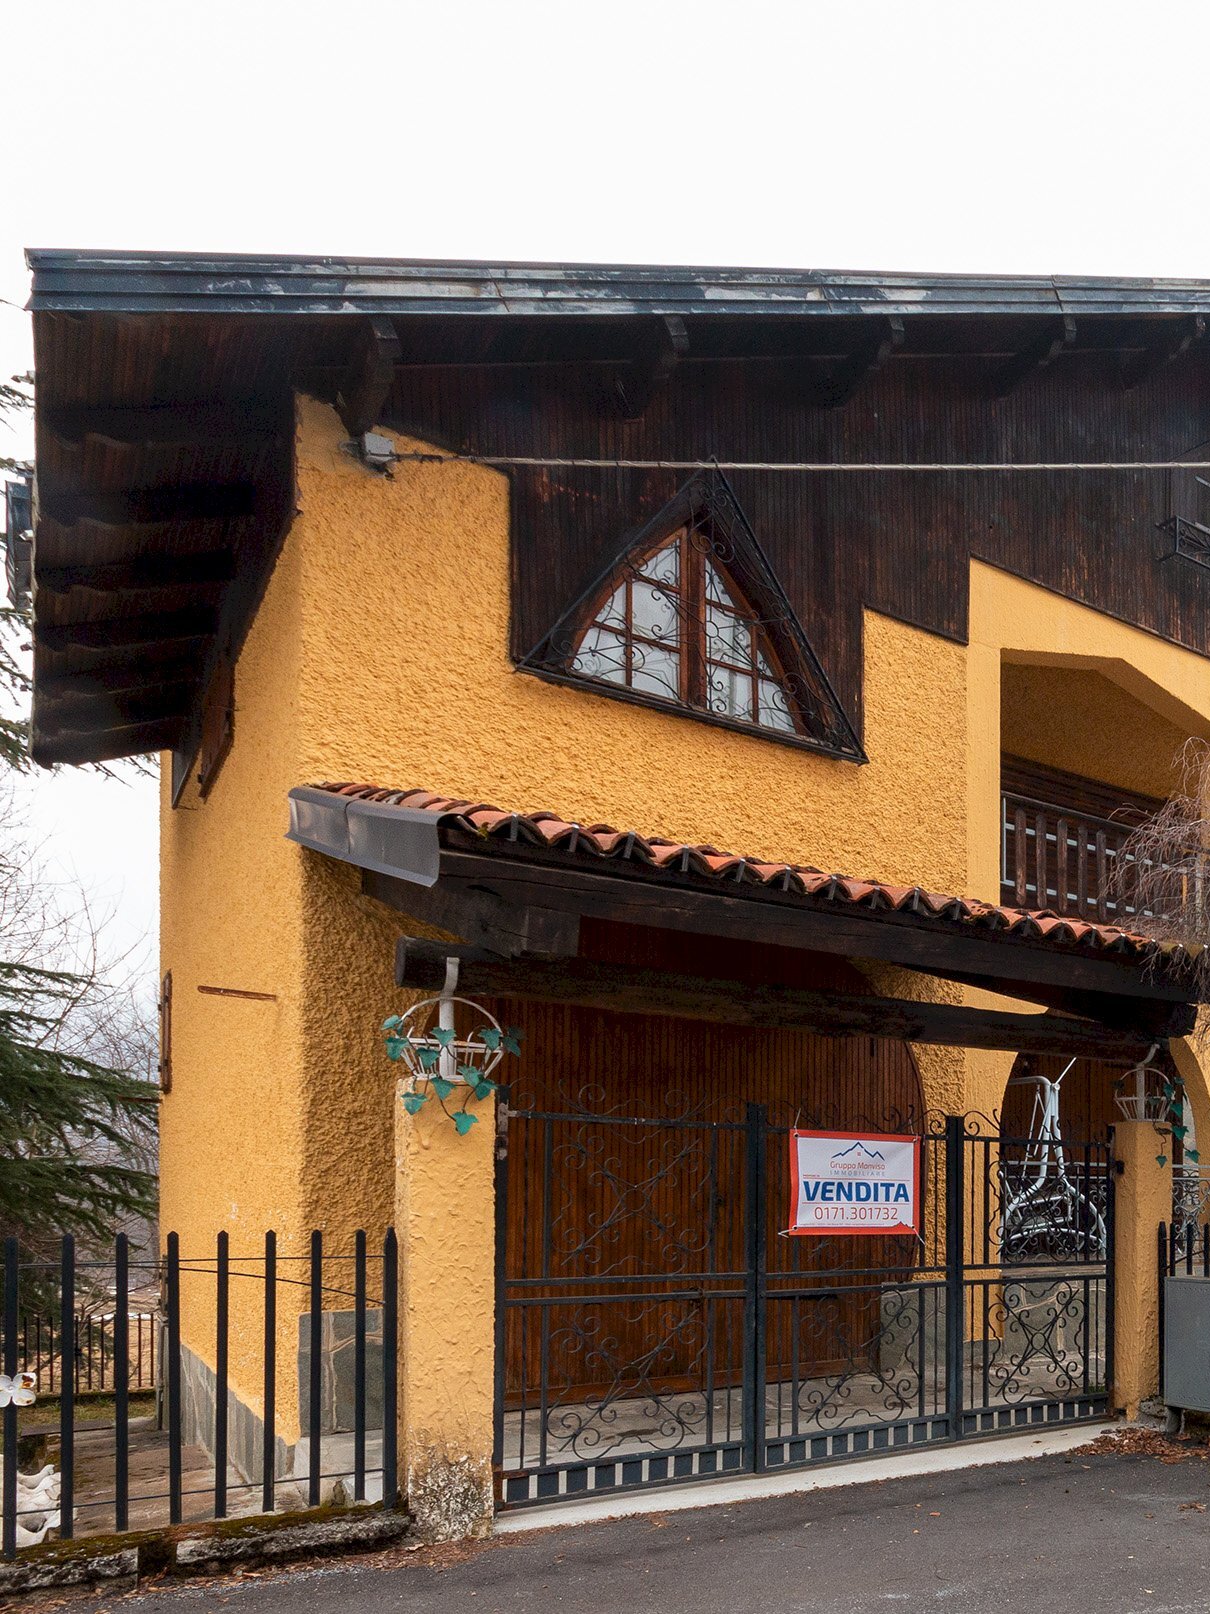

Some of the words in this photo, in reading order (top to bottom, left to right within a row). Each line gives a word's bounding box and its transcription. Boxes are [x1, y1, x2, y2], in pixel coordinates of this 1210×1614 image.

[830, 1161, 856, 1170] Gruppo
[857, 1162, 885, 1170] Monviso
[803, 1181, 910, 1202] VENDITA
[814, 1206, 898, 1220] 0171.301732
